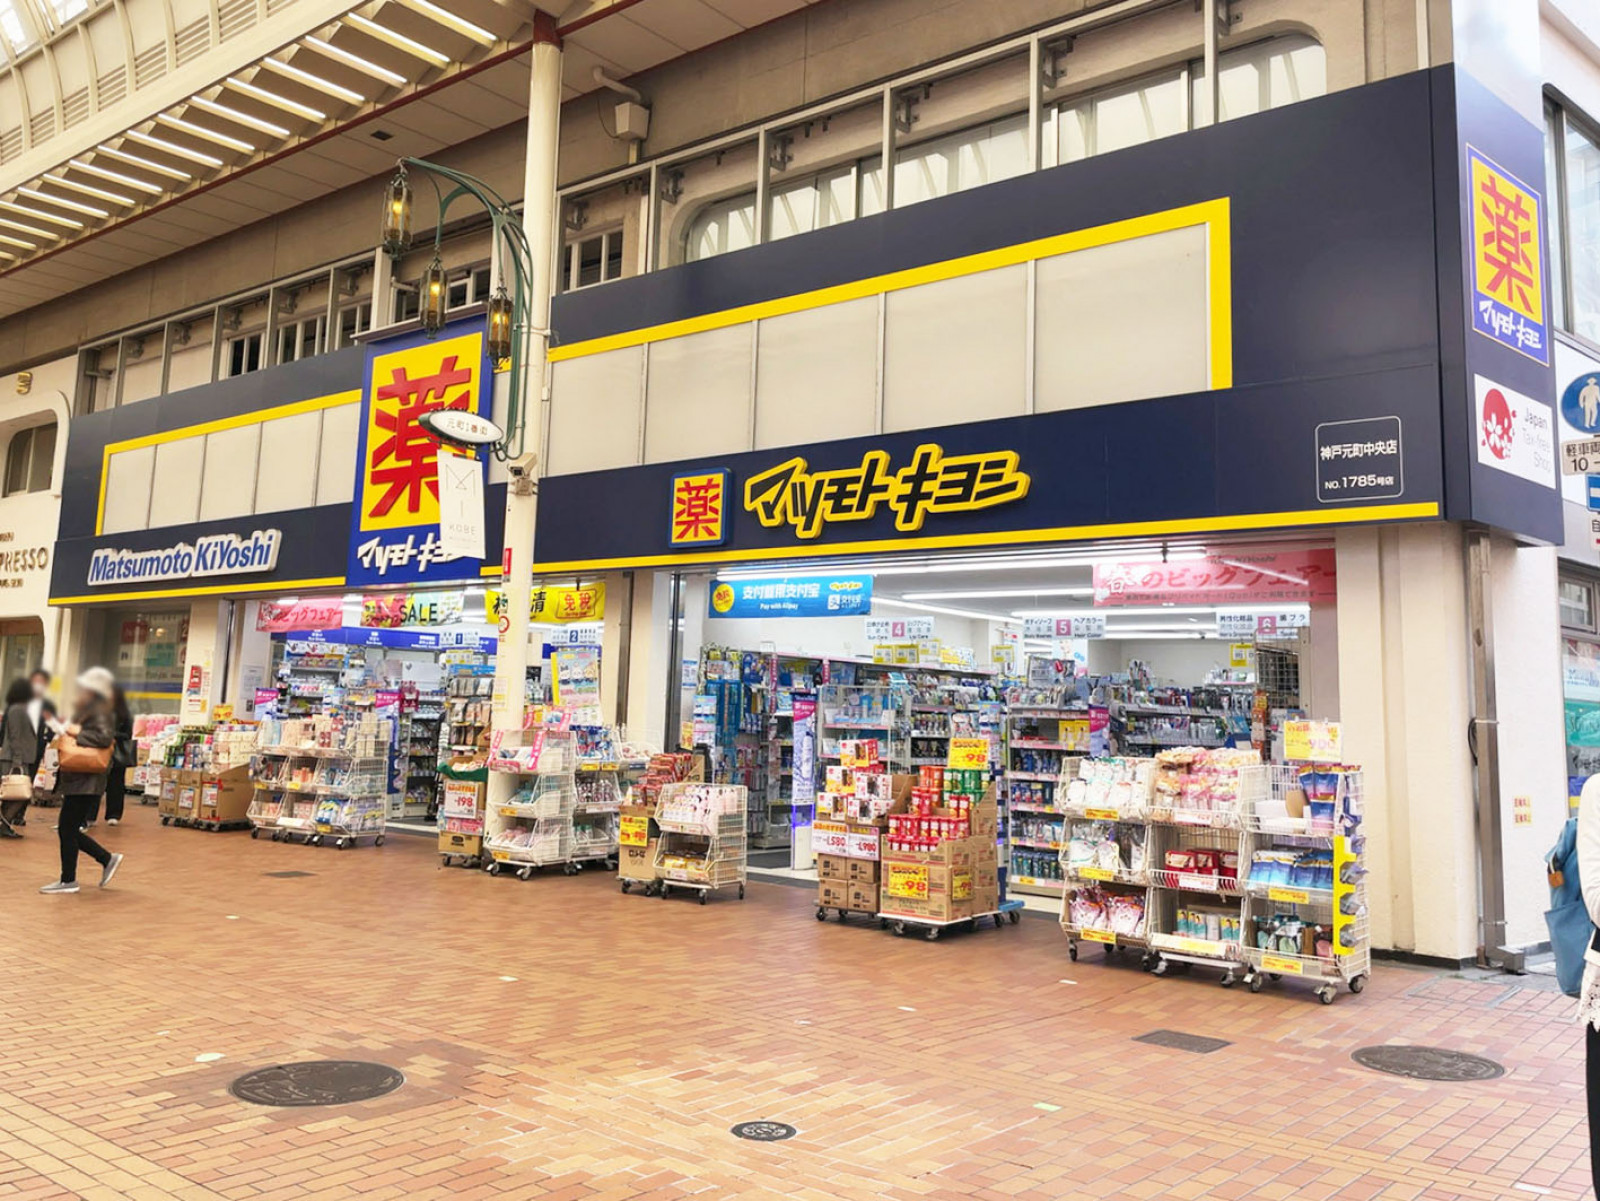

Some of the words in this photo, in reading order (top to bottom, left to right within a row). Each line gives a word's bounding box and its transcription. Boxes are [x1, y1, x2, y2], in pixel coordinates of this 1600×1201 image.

[1481, 174, 1534, 314] 薬
[1479, 299, 1543, 349] マツモトキヨシ
[1525, 407, 1548, 431] Japan
[369, 355, 472, 518] 薬
[1319, 439, 1398, 461] 神戸元町中央店
[675, 477, 721, 540] 薬
[745, 446, 1027, 536] マツモトキヨシ
[89, 549, 193, 583] Matsumoto
[194, 533, 274, 572] KiYoshi
[357, 532, 462, 575] マツモトキ
[398, 602, 438, 623] SALE
[564, 592, 592, 611] 免税
[965, 753, 986, 764] 98
[905, 880, 927, 892] 98
